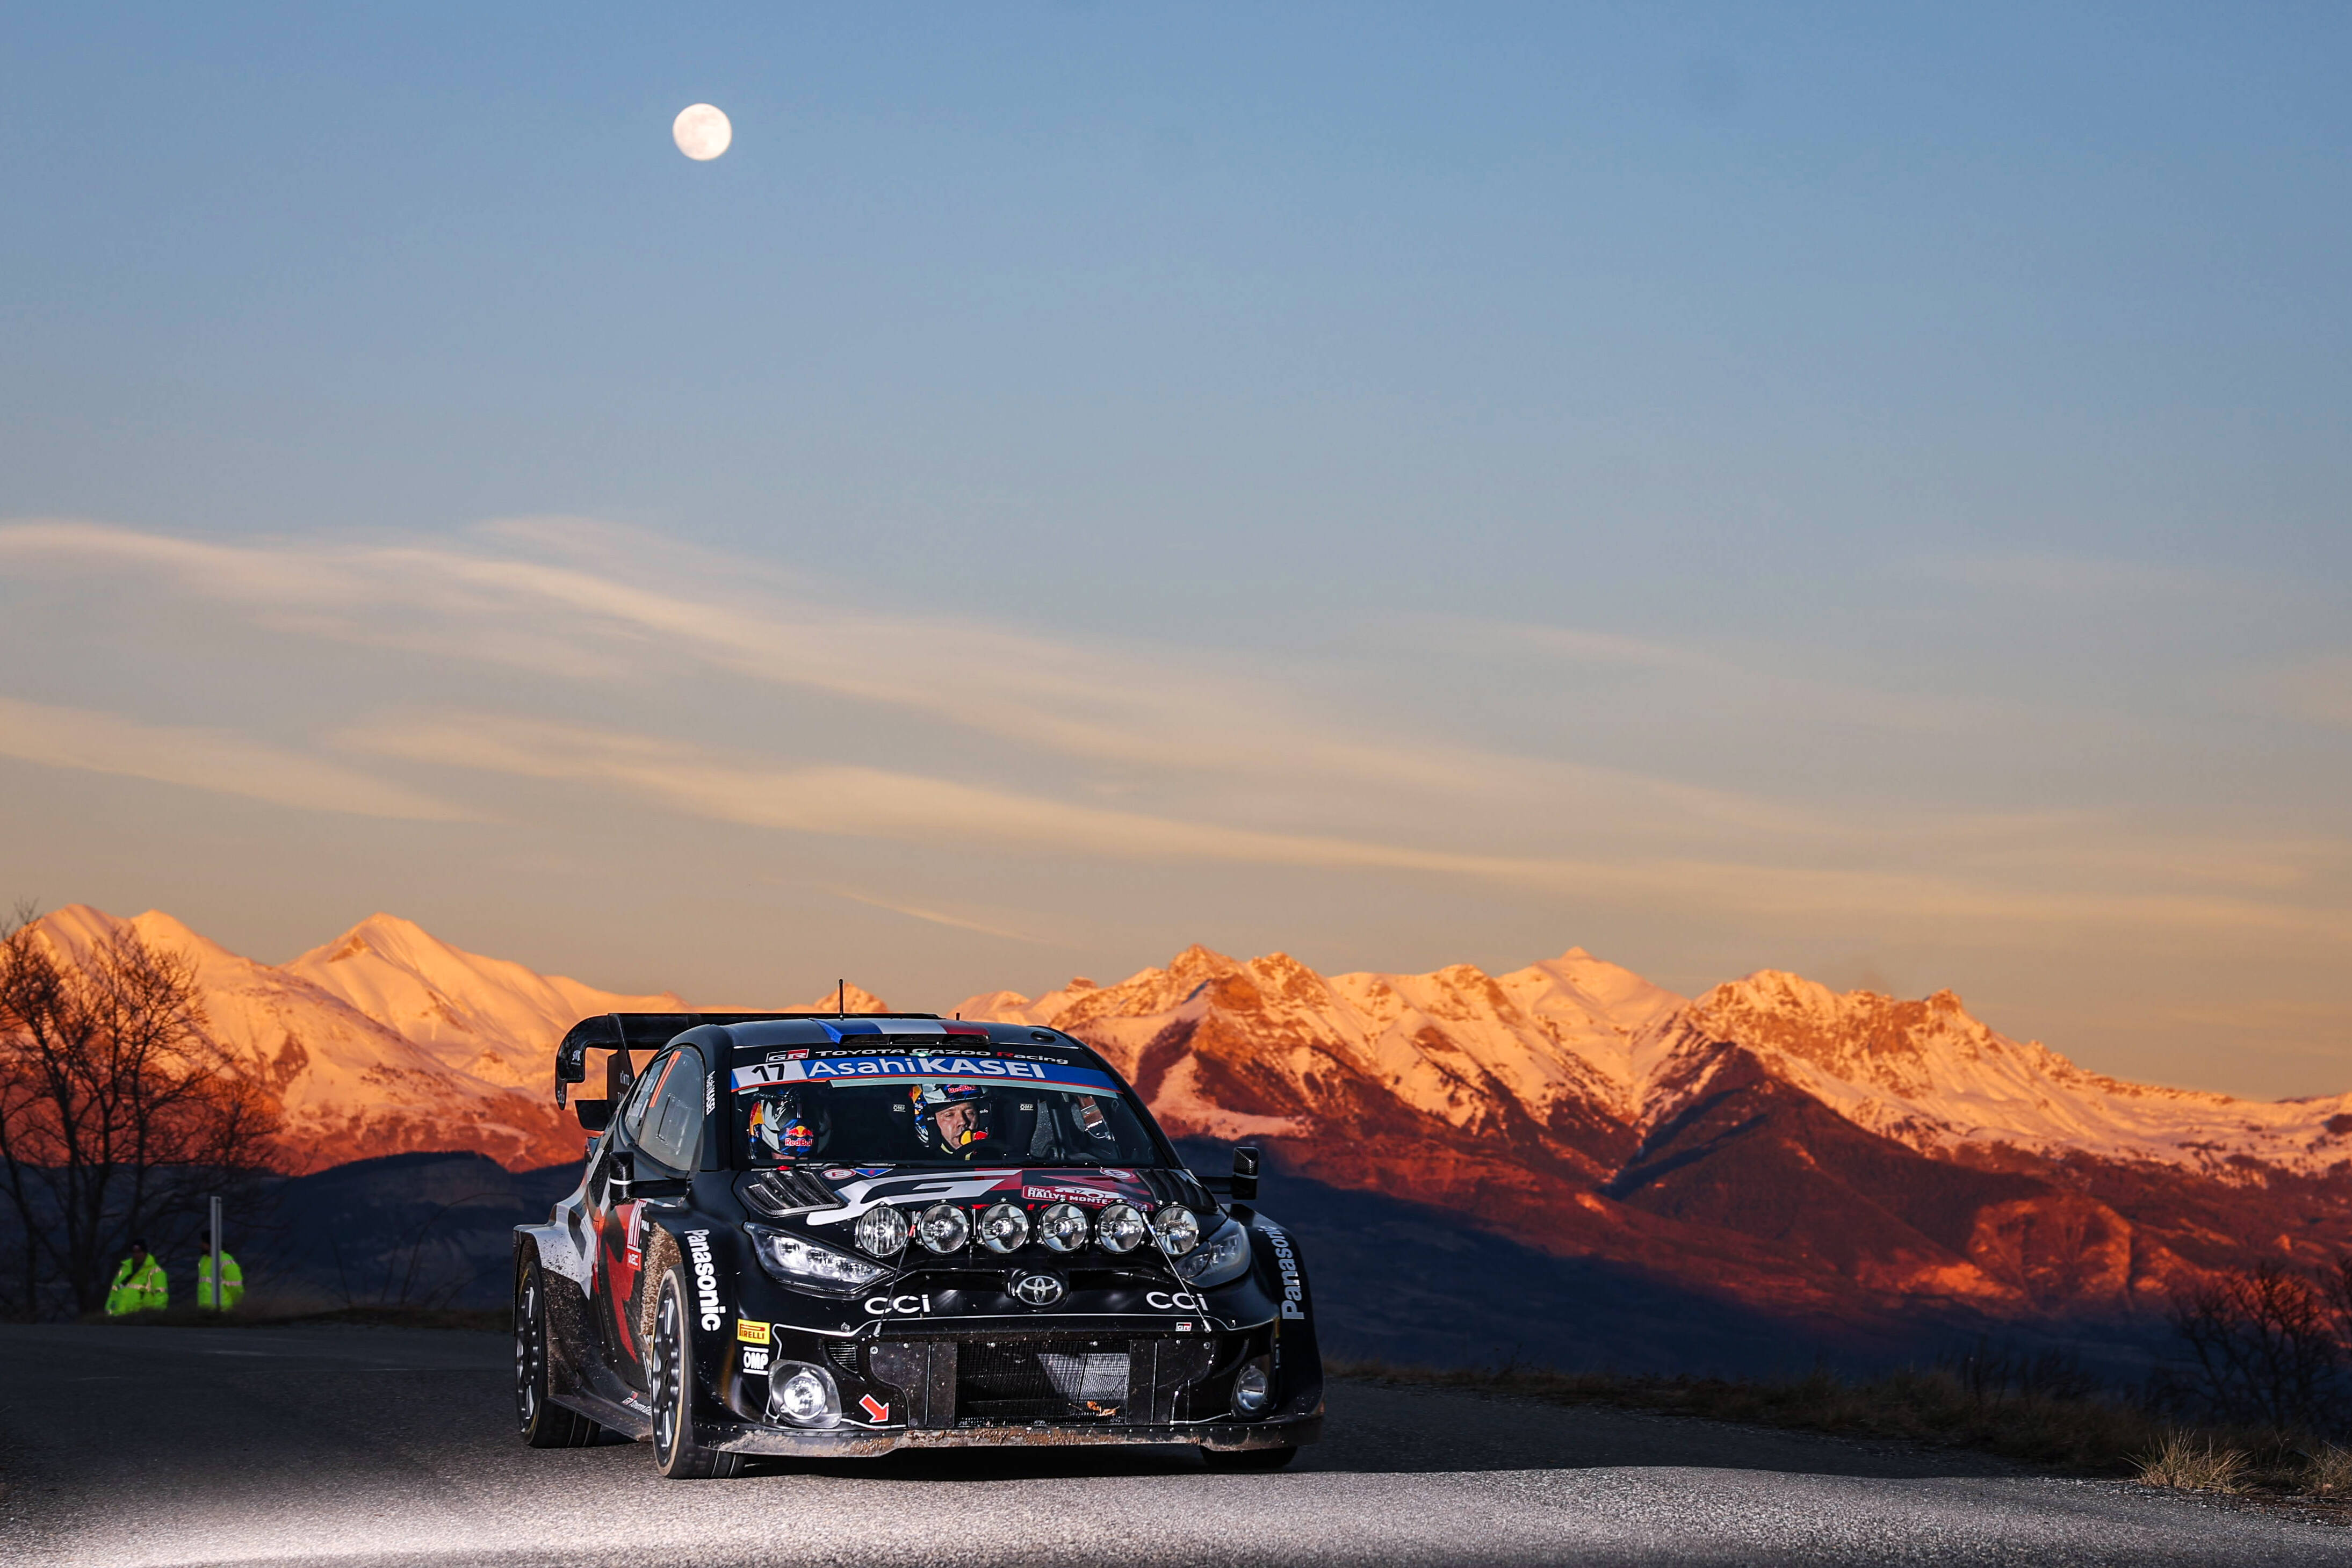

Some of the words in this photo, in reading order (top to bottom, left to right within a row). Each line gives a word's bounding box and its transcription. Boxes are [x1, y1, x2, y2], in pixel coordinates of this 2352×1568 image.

[768, 1052, 806, 1061] GR
[815, 1049, 906, 1057] TOYOTA
[912, 1049, 991, 1057] GAZOO
[997, 1051, 1069, 1065] Racing
[751, 1063, 785, 1082] 17
[1027, 1189, 1066, 1199] RALLYE
[1069, 1195, 1114, 1204] MONTE-
[684, 1229, 726, 1331] Panasonic
[1258, 1225, 1305, 1320] Panasonic
[739, 1323, 765, 1340] PIRELLI
[743, 1351, 769, 1370] OMP
